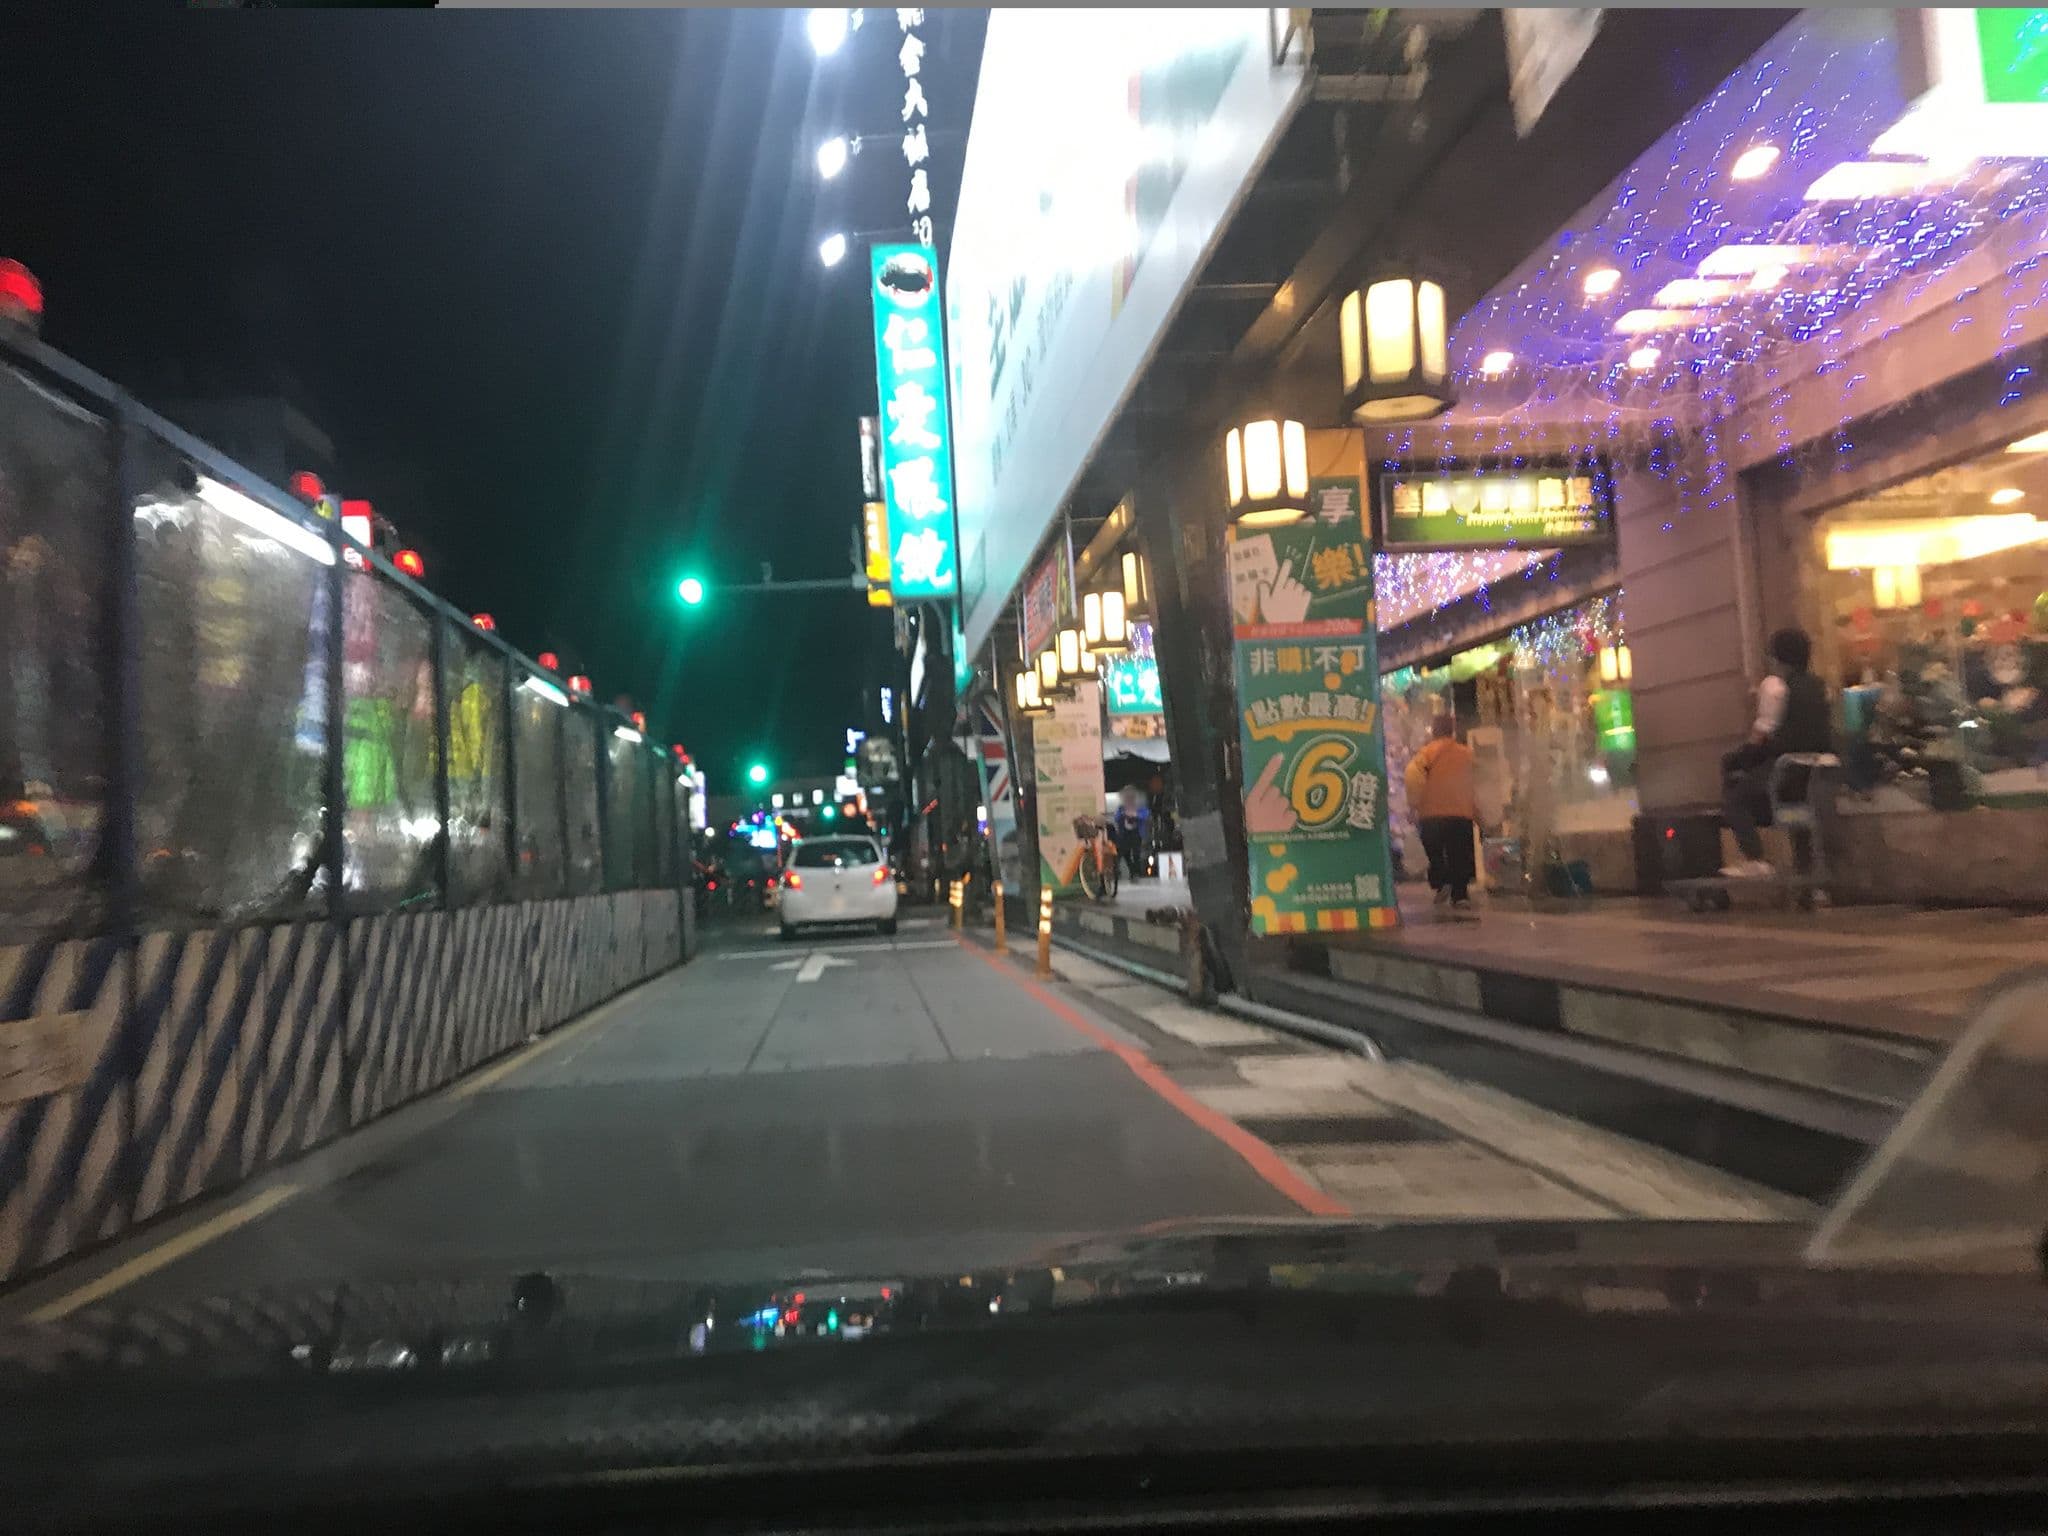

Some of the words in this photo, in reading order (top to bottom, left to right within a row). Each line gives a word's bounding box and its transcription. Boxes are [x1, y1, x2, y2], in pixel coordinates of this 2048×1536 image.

[1250, 691, 1369, 728] 點數最高!
[1289, 739, 1354, 826] 6
[1347, 770, 1379, 830] 倍送
